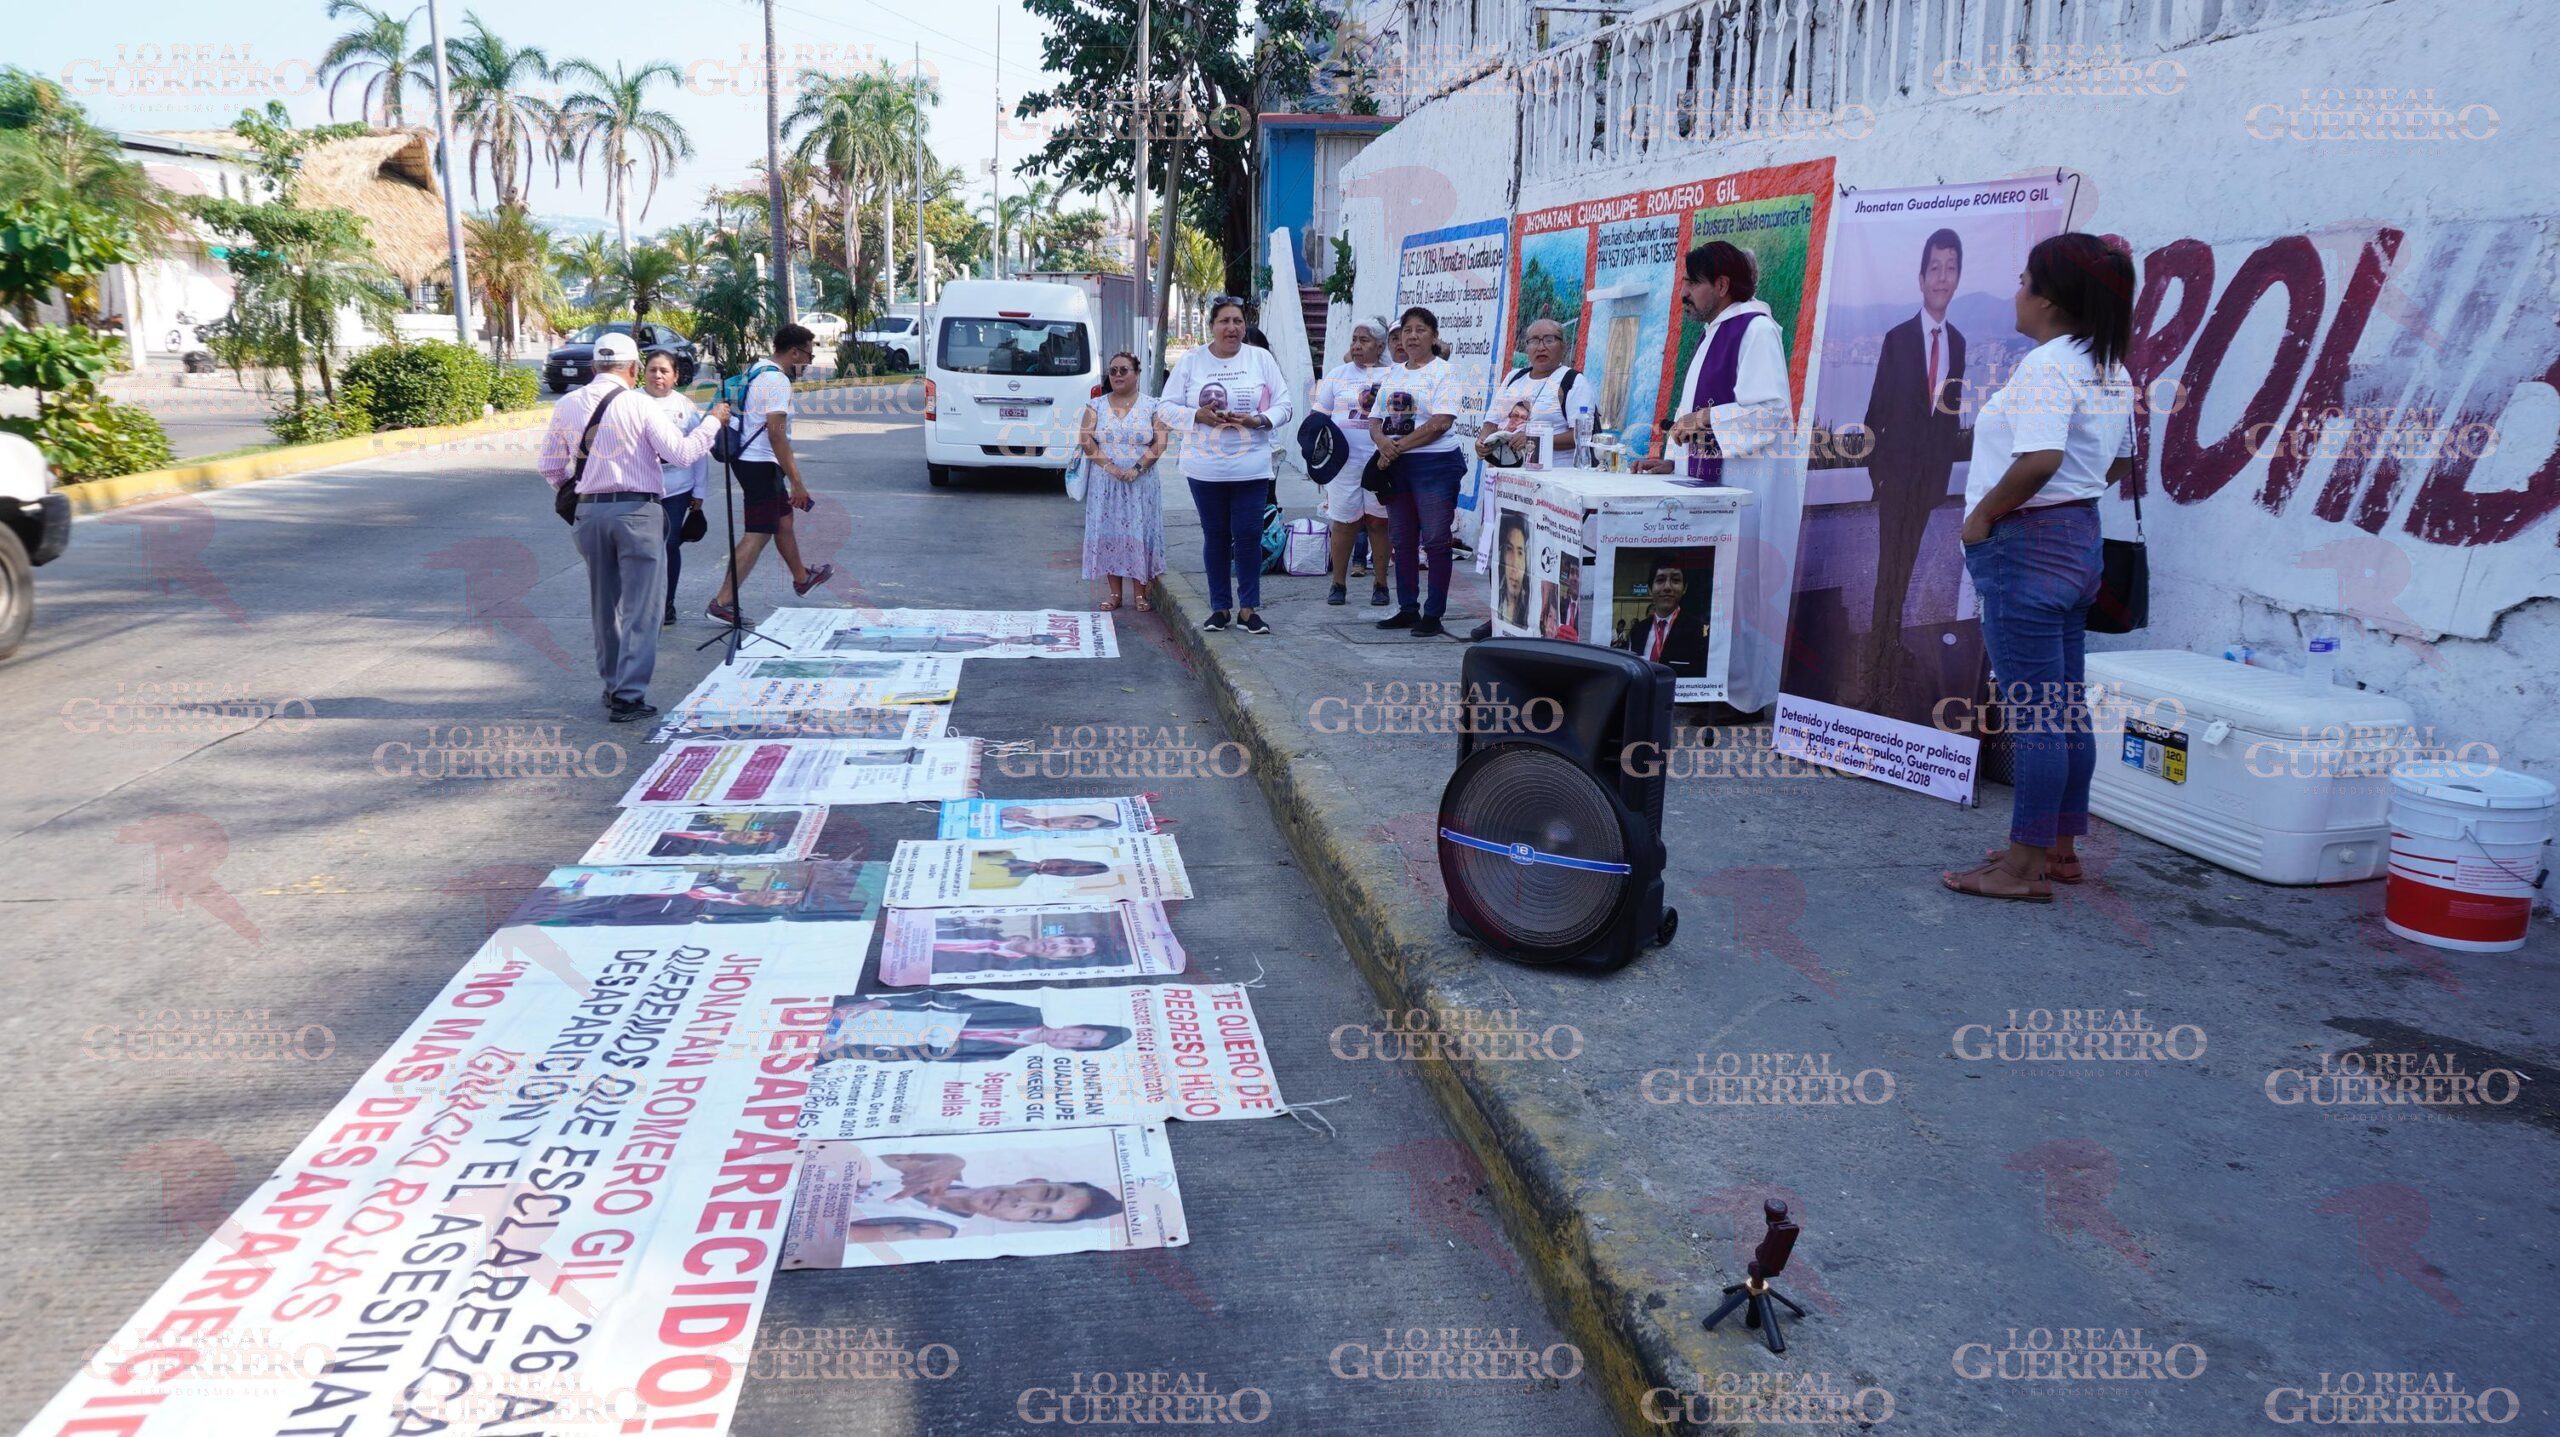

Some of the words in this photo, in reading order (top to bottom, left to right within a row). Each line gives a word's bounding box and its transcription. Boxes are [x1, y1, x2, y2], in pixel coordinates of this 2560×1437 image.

[1523, 209, 1573, 233] JHONATAN
[1577, 197, 1639, 225] GUADALUPE
[1646, 184, 1706, 215] ROMERO
[1716, 178, 1741, 203] GIL
[1735, 207, 1759, 233] hasta
[1758, 200, 1812, 230] encontrarte
[1854, 197, 1904, 215] Jhonatan
[1907, 194, 1971, 212] Guadalupe
[1972, 189, 2026, 207] ROMERO
[2028, 187, 2050, 202] GIL
[1467, 241, 1503, 272] Guadalupe
[1463, 277, 1499, 306] desaparecido
[1475, 305, 1483, 328] de
[1600, 535, 1639, 544] Jhonatan
[1641, 534, 1684, 545] Guadalupe
[1686, 534, 1718, 543] Romero
[1720, 533, 1732, 542] Gil
[1643, 522, 1657, 532] Soy
[1658, 522, 1665, 530] la
[1685, 682, 1718, 691] municipales
[1780, 706, 1823, 728] Detenido
[1822, 717, 1831, 735] y
[1831, 718, 1904, 750] desaparecido
[1905, 738, 1927, 758] por
[1778, 723, 1836, 748] municipales
[1836, 738, 1850, 752] en
[1852, 739, 1905, 769] Acapulco,
[1906, 756, 1957, 781] Guerrero
[1958, 767, 1971, 783] el
[1805, 743, 1819, 758] 05
[1819, 746, 1832, 763] de
[1834, 749, 1886, 775] diciembre
[1887, 763, 1905, 781] del
[1906, 768, 1931, 788] 2018
[2166, 749, 2182, 762] 120
[1515, 845, 1529, 856] 18
[601, 944, 711, 1070] QUEREMOS
[665, 953, 763, 1069] JHONATAN
[1131, 989, 1151, 998] Te
[1211, 990, 1244, 1012] TE
[498, 948, 659, 1122] DESAPARICIÓN
[1162, 988, 1209, 1069] REGRESO
[1215, 1014, 1265, 1079] QUIERO
[384, 1018, 487, 1084] MAS
[855, 1064, 872, 1073] de
[846, 1073, 869, 1107] Diciembre
[890, 1068, 914, 1114] Desaparecido
[1026, 1055, 1045, 1101] ROMERO
[1053, 1057, 1076, 1121] GUADALUPE
[1081, 1058, 1104, 1116] JONATHAN
[1178, 1073, 1222, 1117] HIJO
[1235, 1084, 1275, 1111] DE
[394, 1045, 527, 1167] IGNACIO
[558, 1072, 638, 1138] QUE
[843, 1106, 858, 1119] del
[888, 1113, 902, 1124] en
[941, 1080, 973, 1118] huellas
[978, 1109, 1006, 1128] tus
[1025, 1103, 1045, 1123] GIL
[483, 1126, 542, 1148] Y
[593, 1077, 708, 1216] ROMERO
[838, 1119, 858, 1138] 2018
[439, 1158, 520, 1203] EL
[814, 1164, 829, 1182] Lugar
[842, 1161, 858, 1182] Fecha
[1119, 1148, 1131, 1173] Alberto
[619, 996, 833, 1436] ¡DESAPARECIDO!
[272, 1178, 425, 1323] ROJAS
[548, 1228, 636, 1296] GIL
[389, 1144, 599, 1437] ESCLAREZCA
[509, 1322, 593, 1375] 26
[478, 1392, 560, 1437] A
